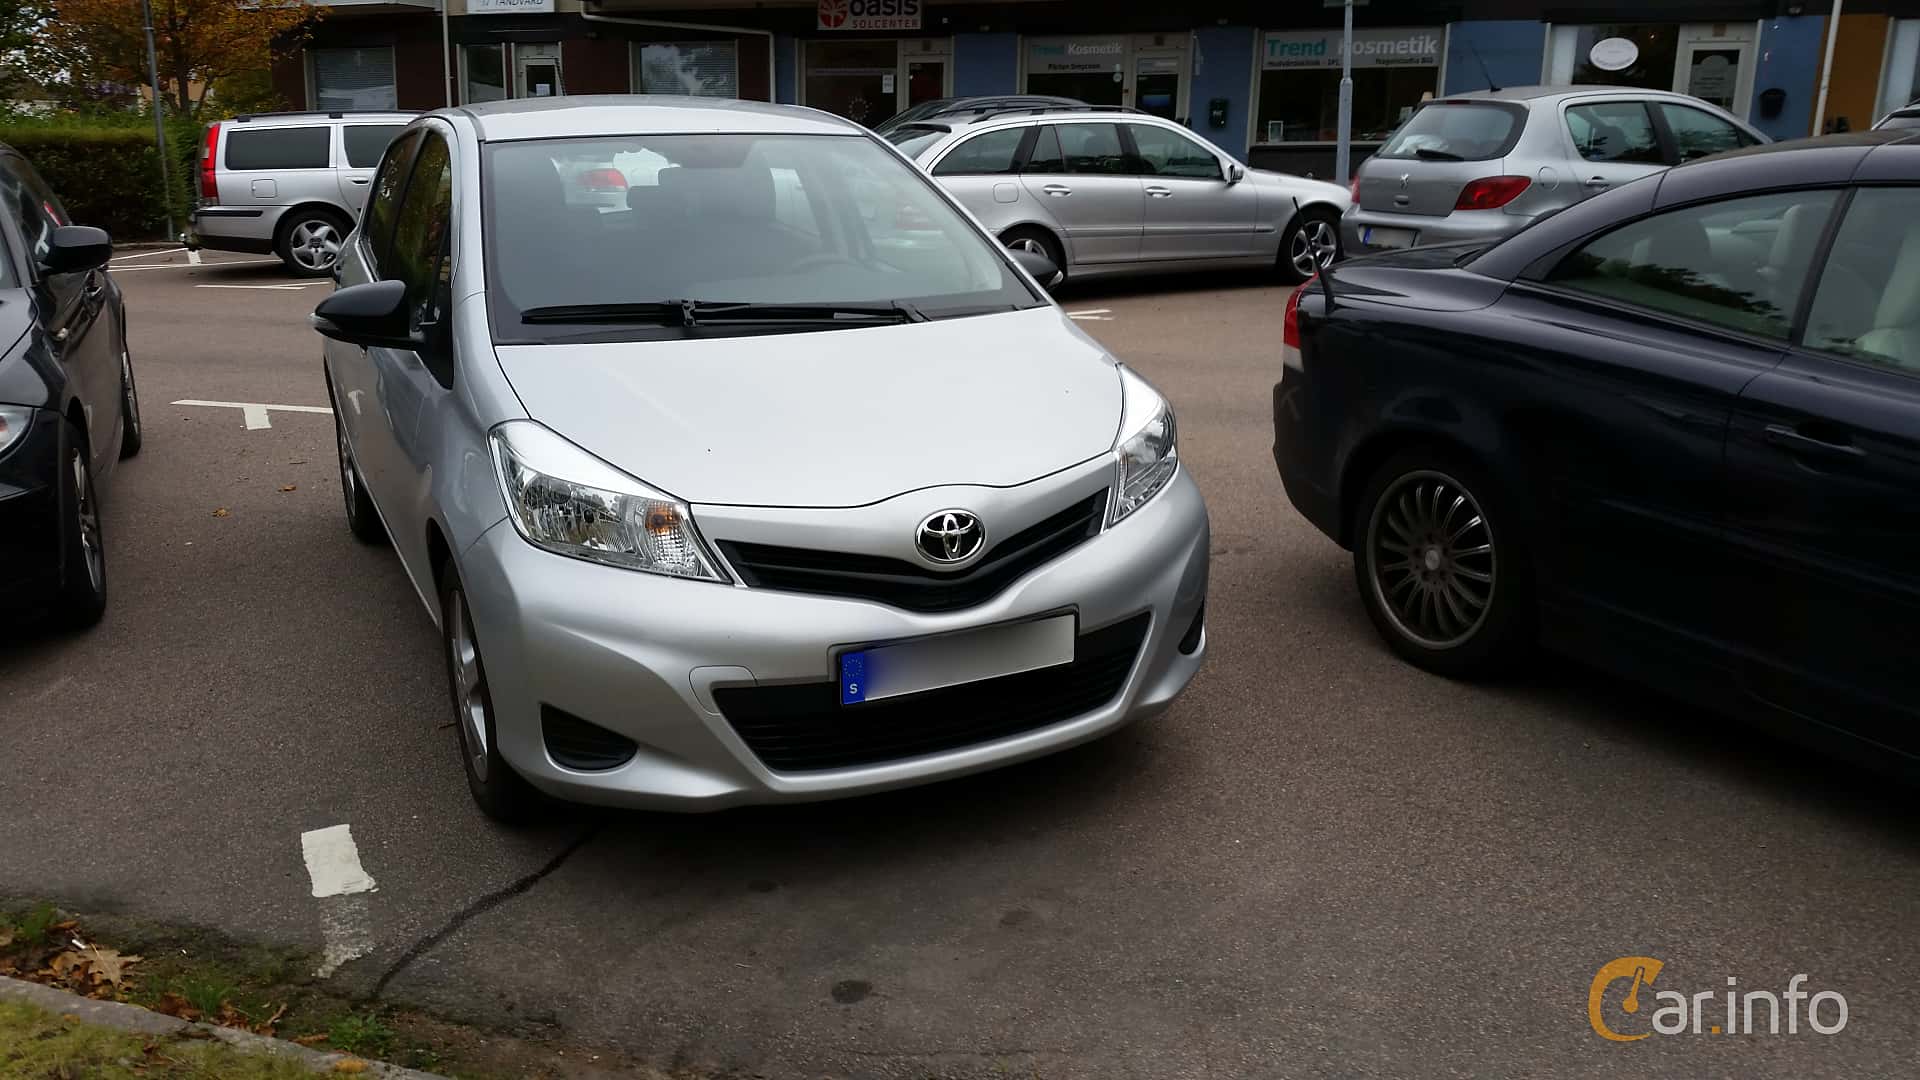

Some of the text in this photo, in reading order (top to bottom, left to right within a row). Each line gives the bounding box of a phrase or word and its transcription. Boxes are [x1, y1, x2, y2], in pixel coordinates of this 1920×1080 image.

[850, 0, 918, 16] oasis
[853, 19, 918, 28] SOLCENTER
[1068, 42, 1121, 55] Kosmetik
[1267, 38, 1327, 56] Trend
[849, 683, 858, 694] S
